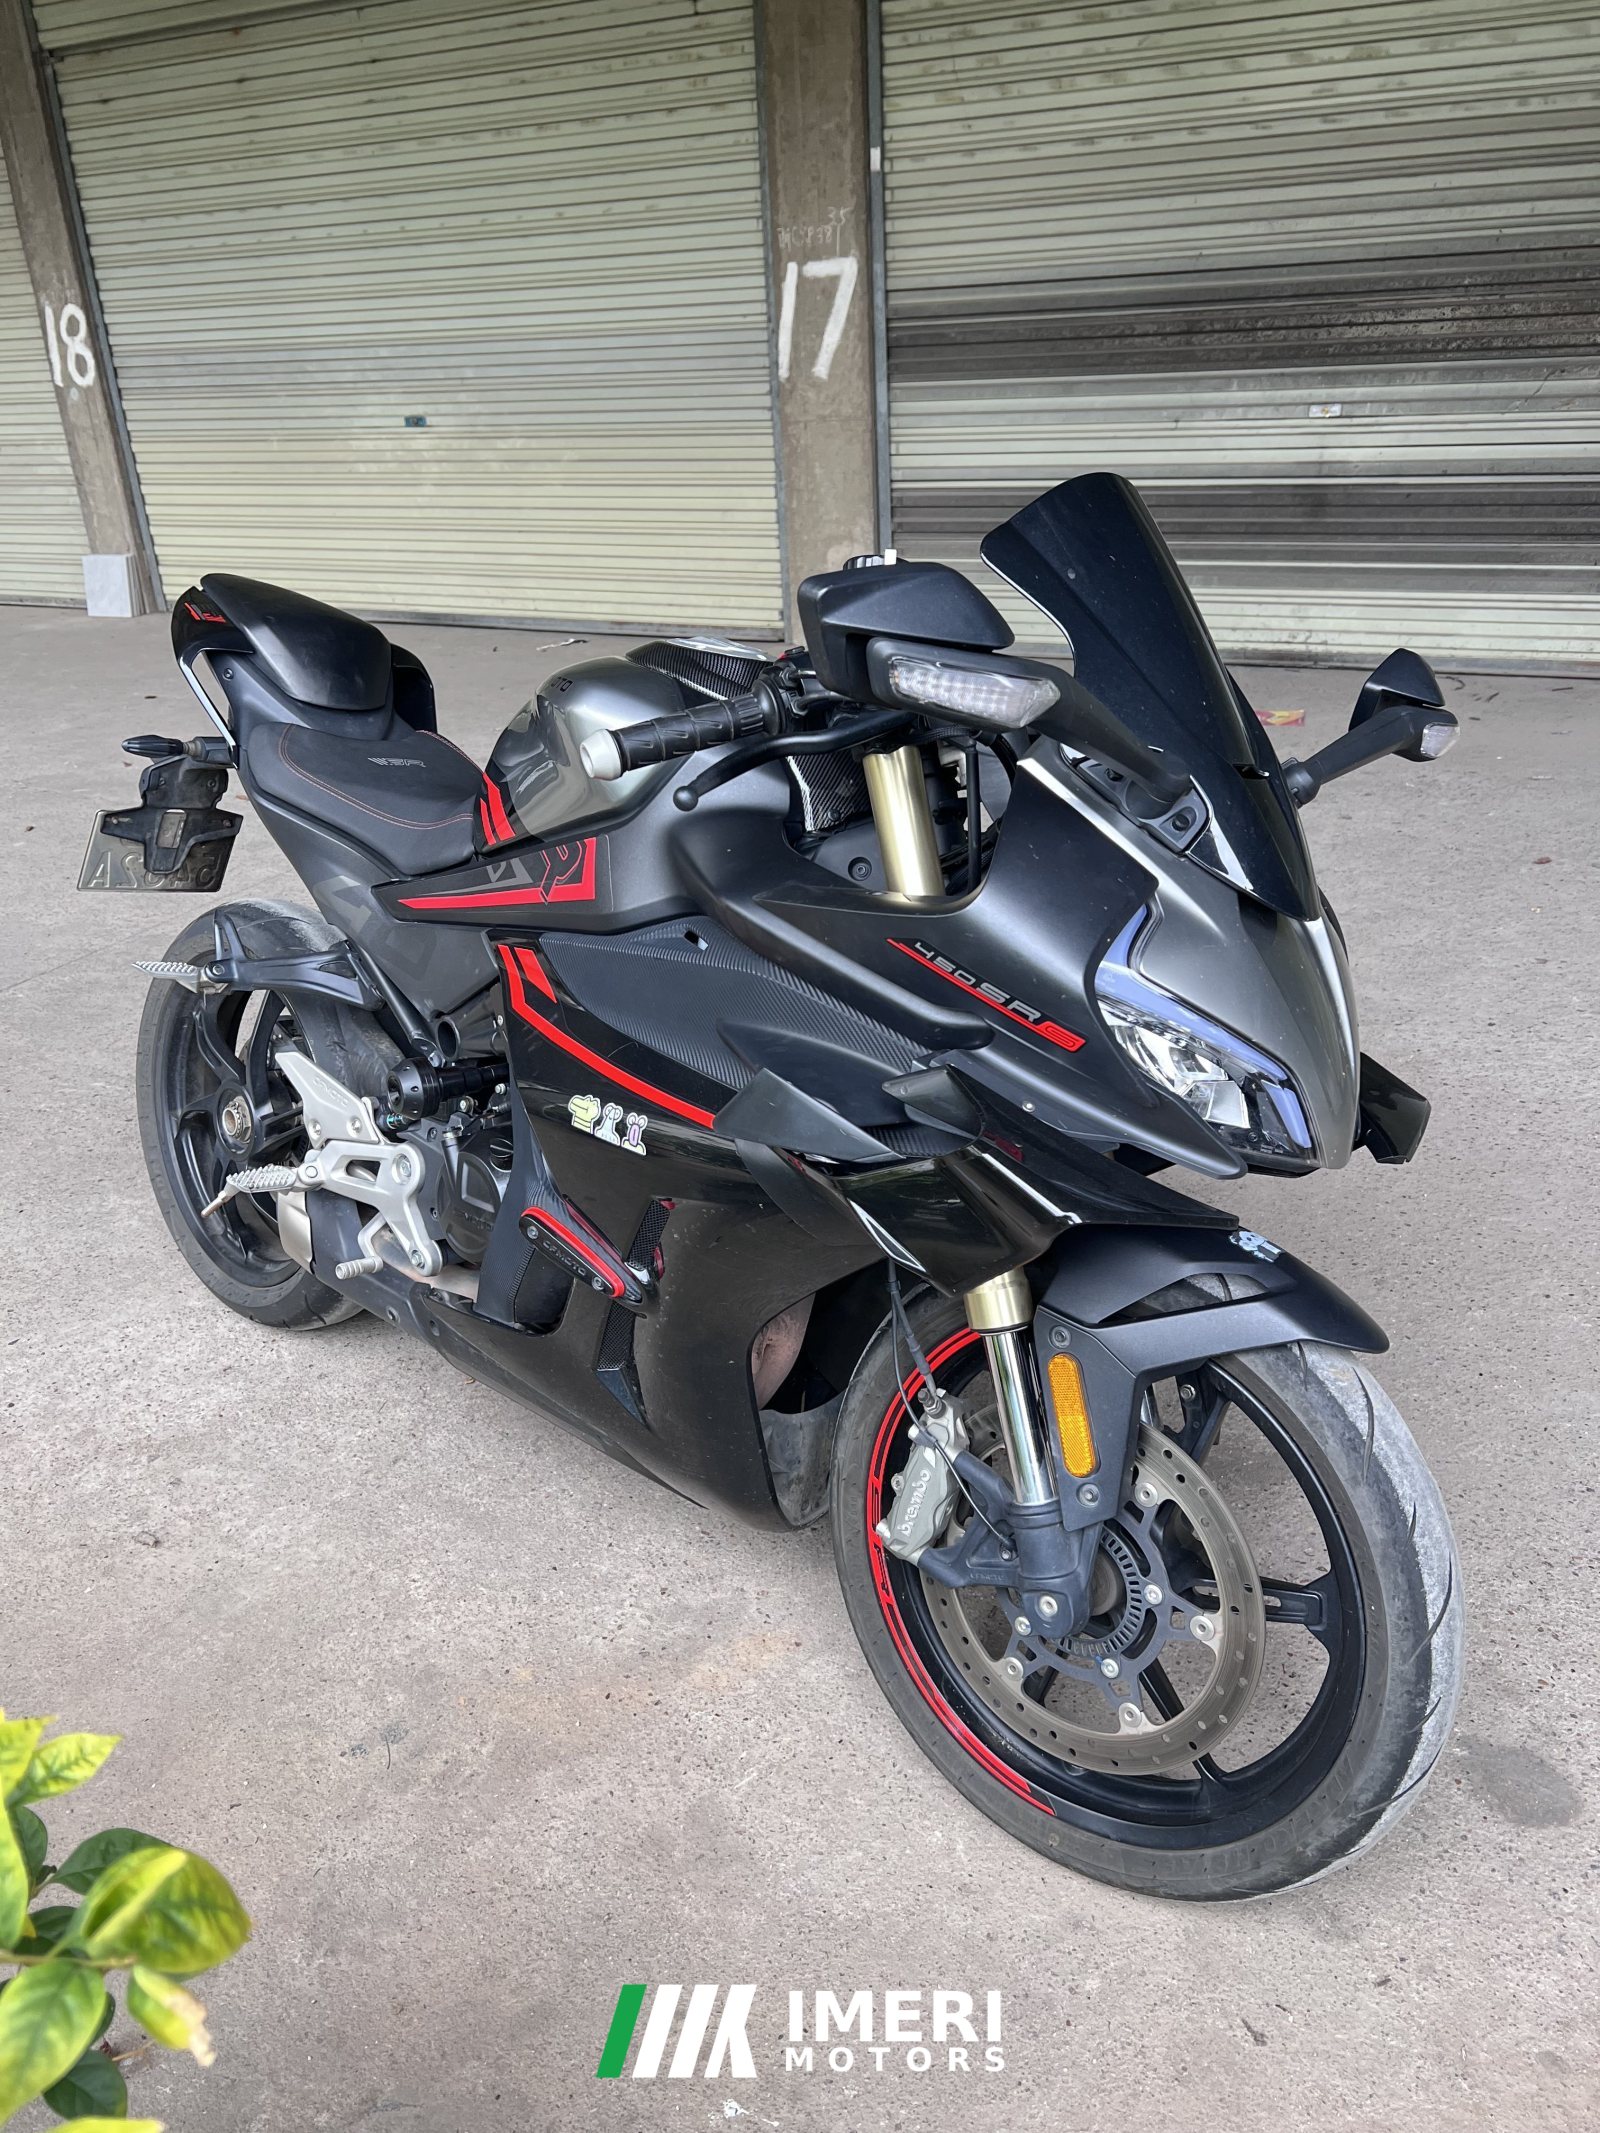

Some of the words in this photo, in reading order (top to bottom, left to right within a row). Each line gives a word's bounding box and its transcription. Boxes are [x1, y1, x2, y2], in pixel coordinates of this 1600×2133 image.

[44, 302, 95, 387] 18
[778, 256, 859, 382] 17
[896, 1469, 933, 1537] brembo
